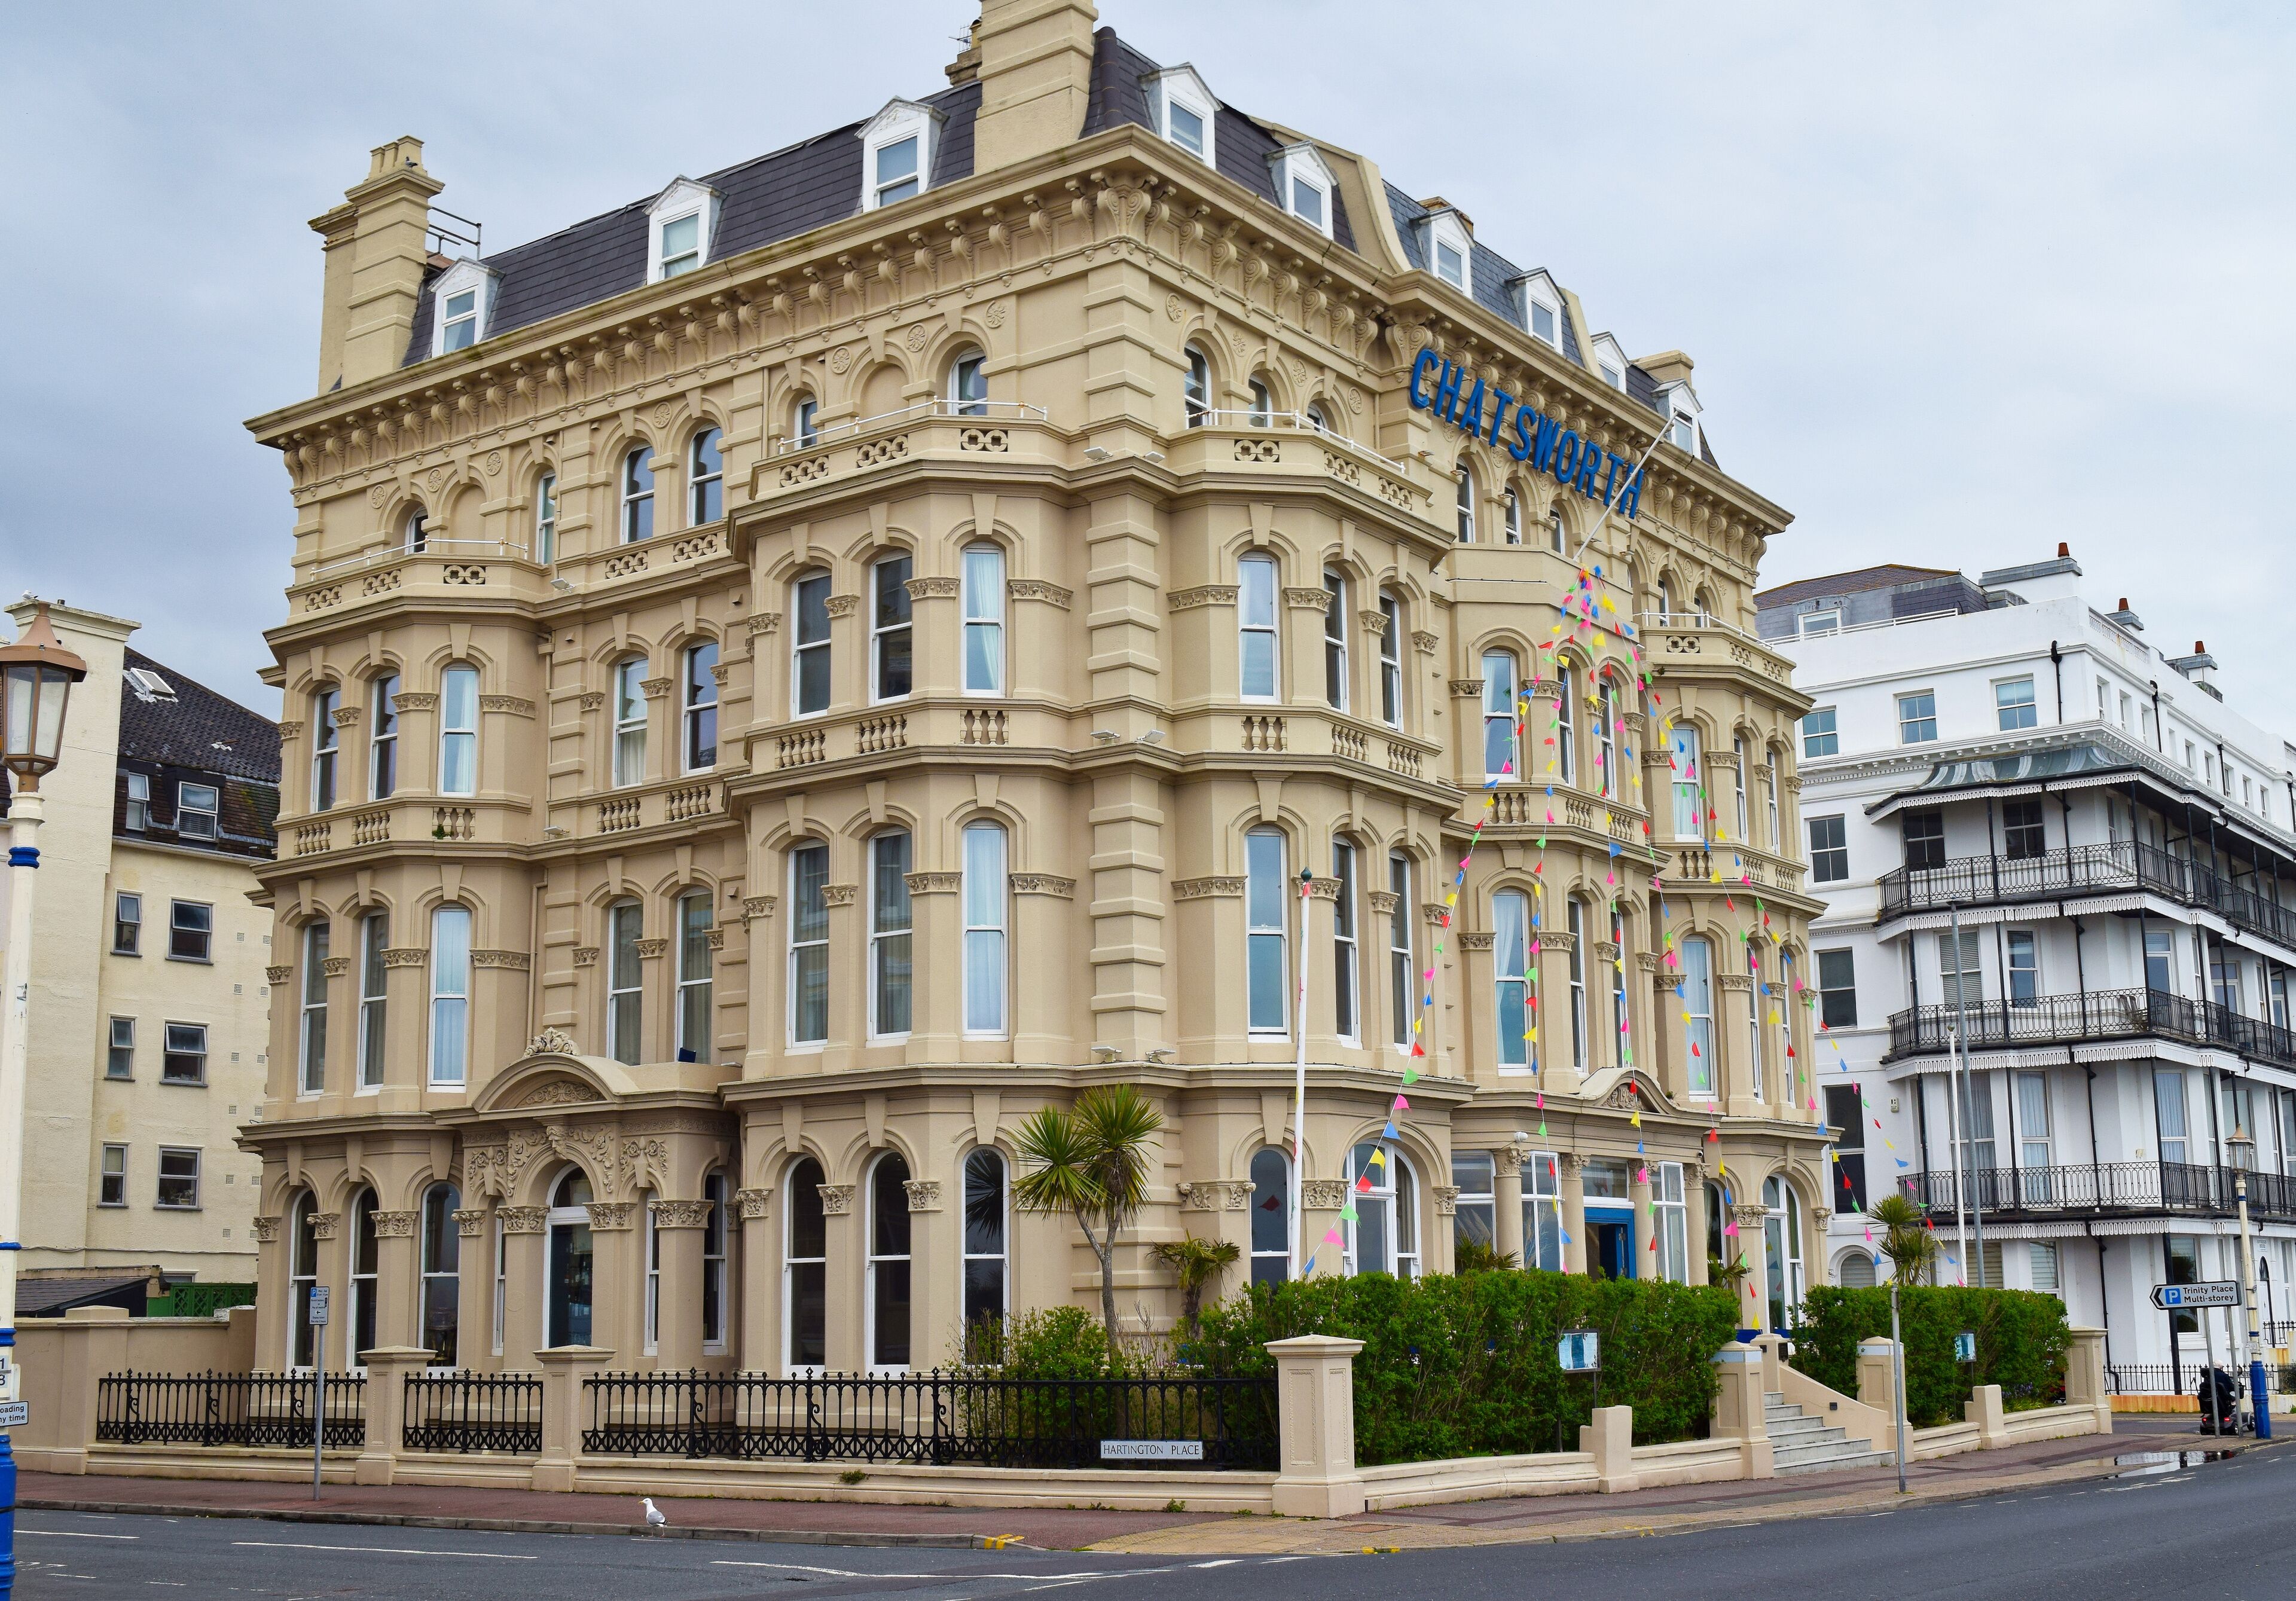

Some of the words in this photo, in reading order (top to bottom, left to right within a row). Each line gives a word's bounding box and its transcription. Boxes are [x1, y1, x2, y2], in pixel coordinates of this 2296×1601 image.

[1410, 349, 1644, 520] CHATSWORTH
[2168, 1290, 2178, 1303] P
[1104, 1444, 1163, 1455] HARTINGTON
[1171, 1445, 1199, 1455] PLACE
